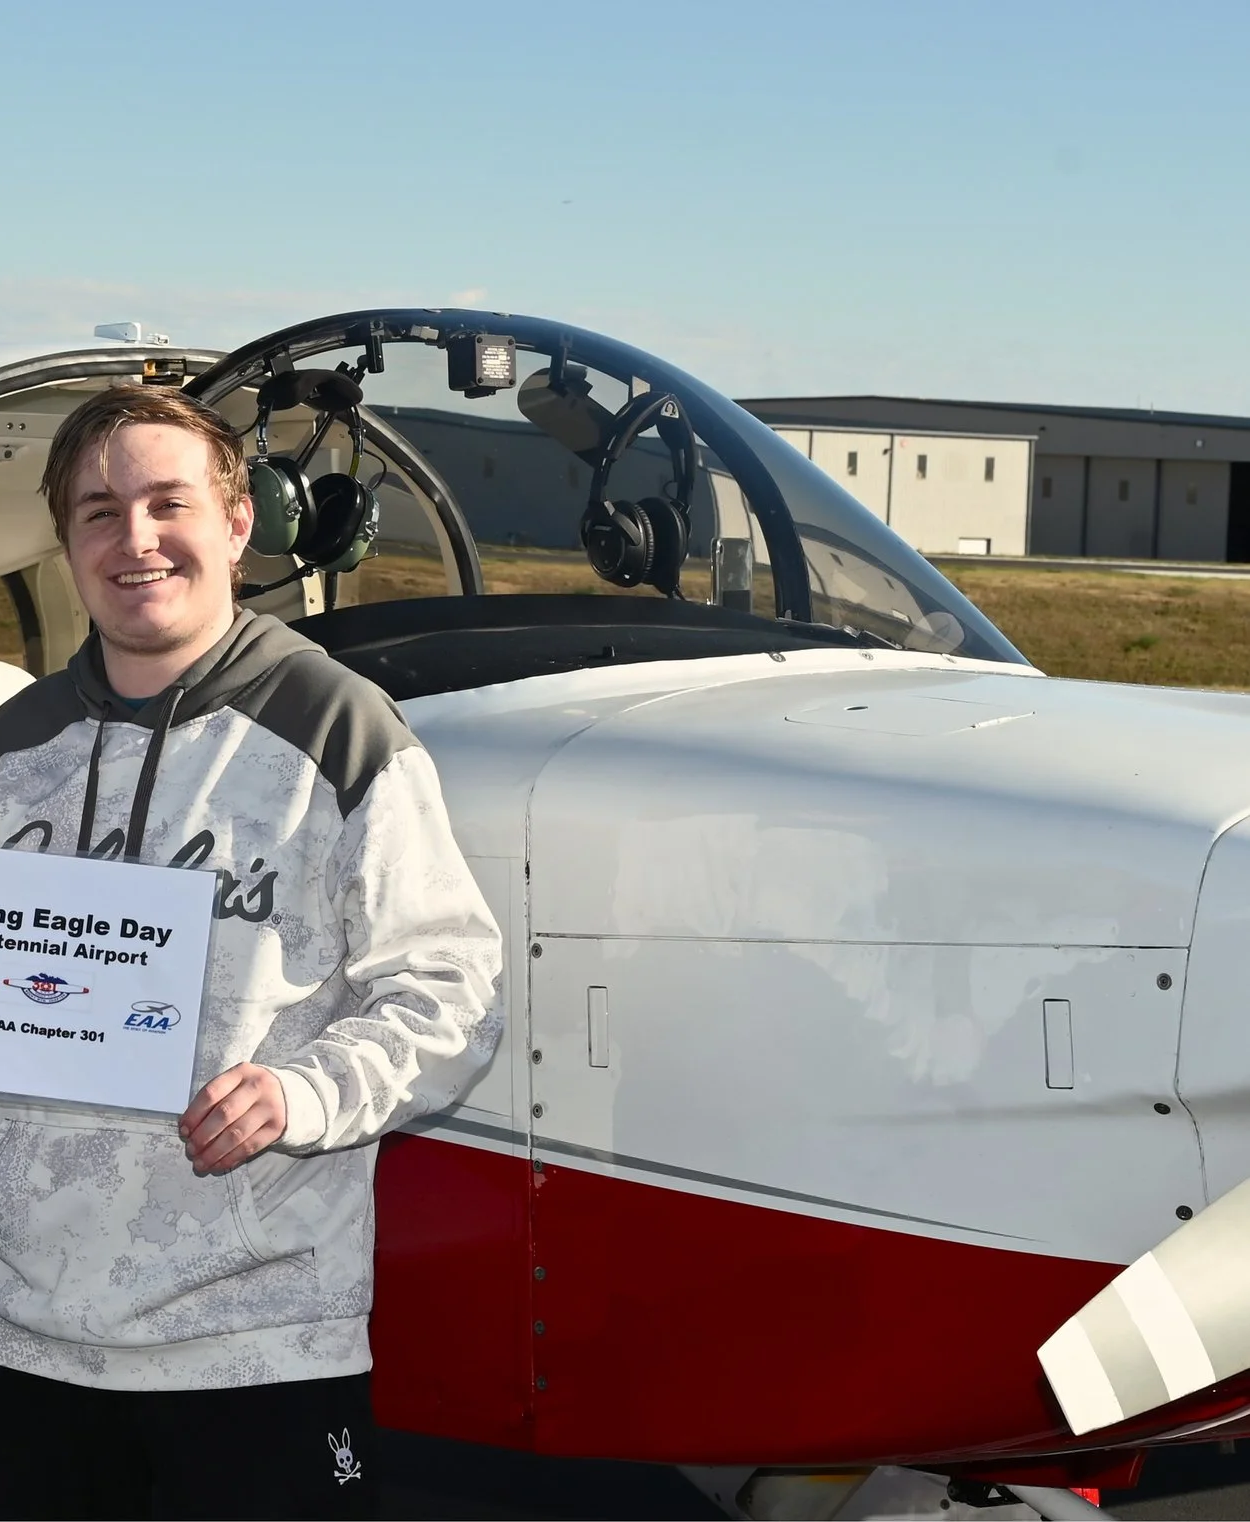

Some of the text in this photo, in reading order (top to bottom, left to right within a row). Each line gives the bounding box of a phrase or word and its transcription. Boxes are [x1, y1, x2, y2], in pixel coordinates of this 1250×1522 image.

[32, 907, 111, 938] Eagle
[119, 918, 173, 948] Day
[73, 943, 149, 967] Airport
[20, 1022, 77, 1039] Chapter
[79, 1029, 105, 1043] 301
[124, 1013, 170, 1031] EAA
